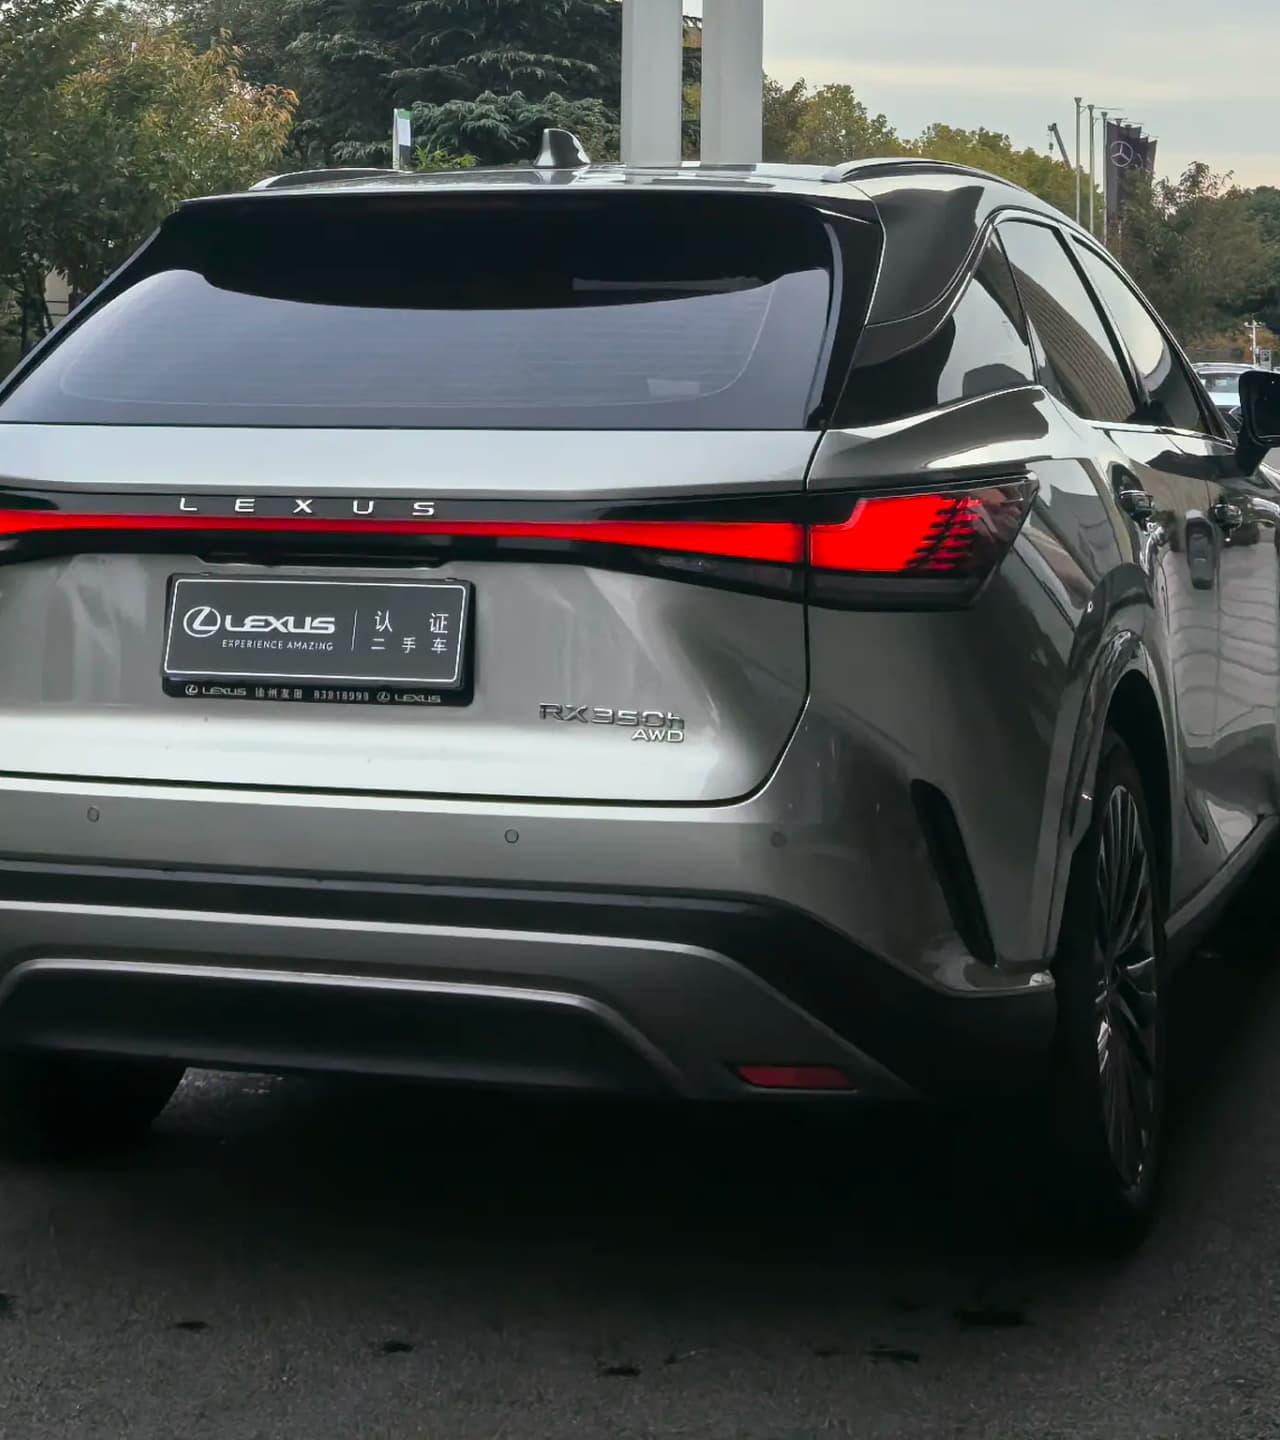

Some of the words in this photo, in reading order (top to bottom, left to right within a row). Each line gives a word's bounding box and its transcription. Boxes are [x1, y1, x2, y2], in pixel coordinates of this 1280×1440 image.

[179, 497, 435, 516] LEXUS
[224, 614, 336, 634] LEXUS
[221, 639, 283, 649] EXPERIENCE
[286, 641, 334, 651] AMAZING
[370, 637, 448, 654] 二手车
[202, 686, 247, 696] LEXUS
[394, 693, 441, 703] LEXUS
[631, 728, 685, 743] AWD
